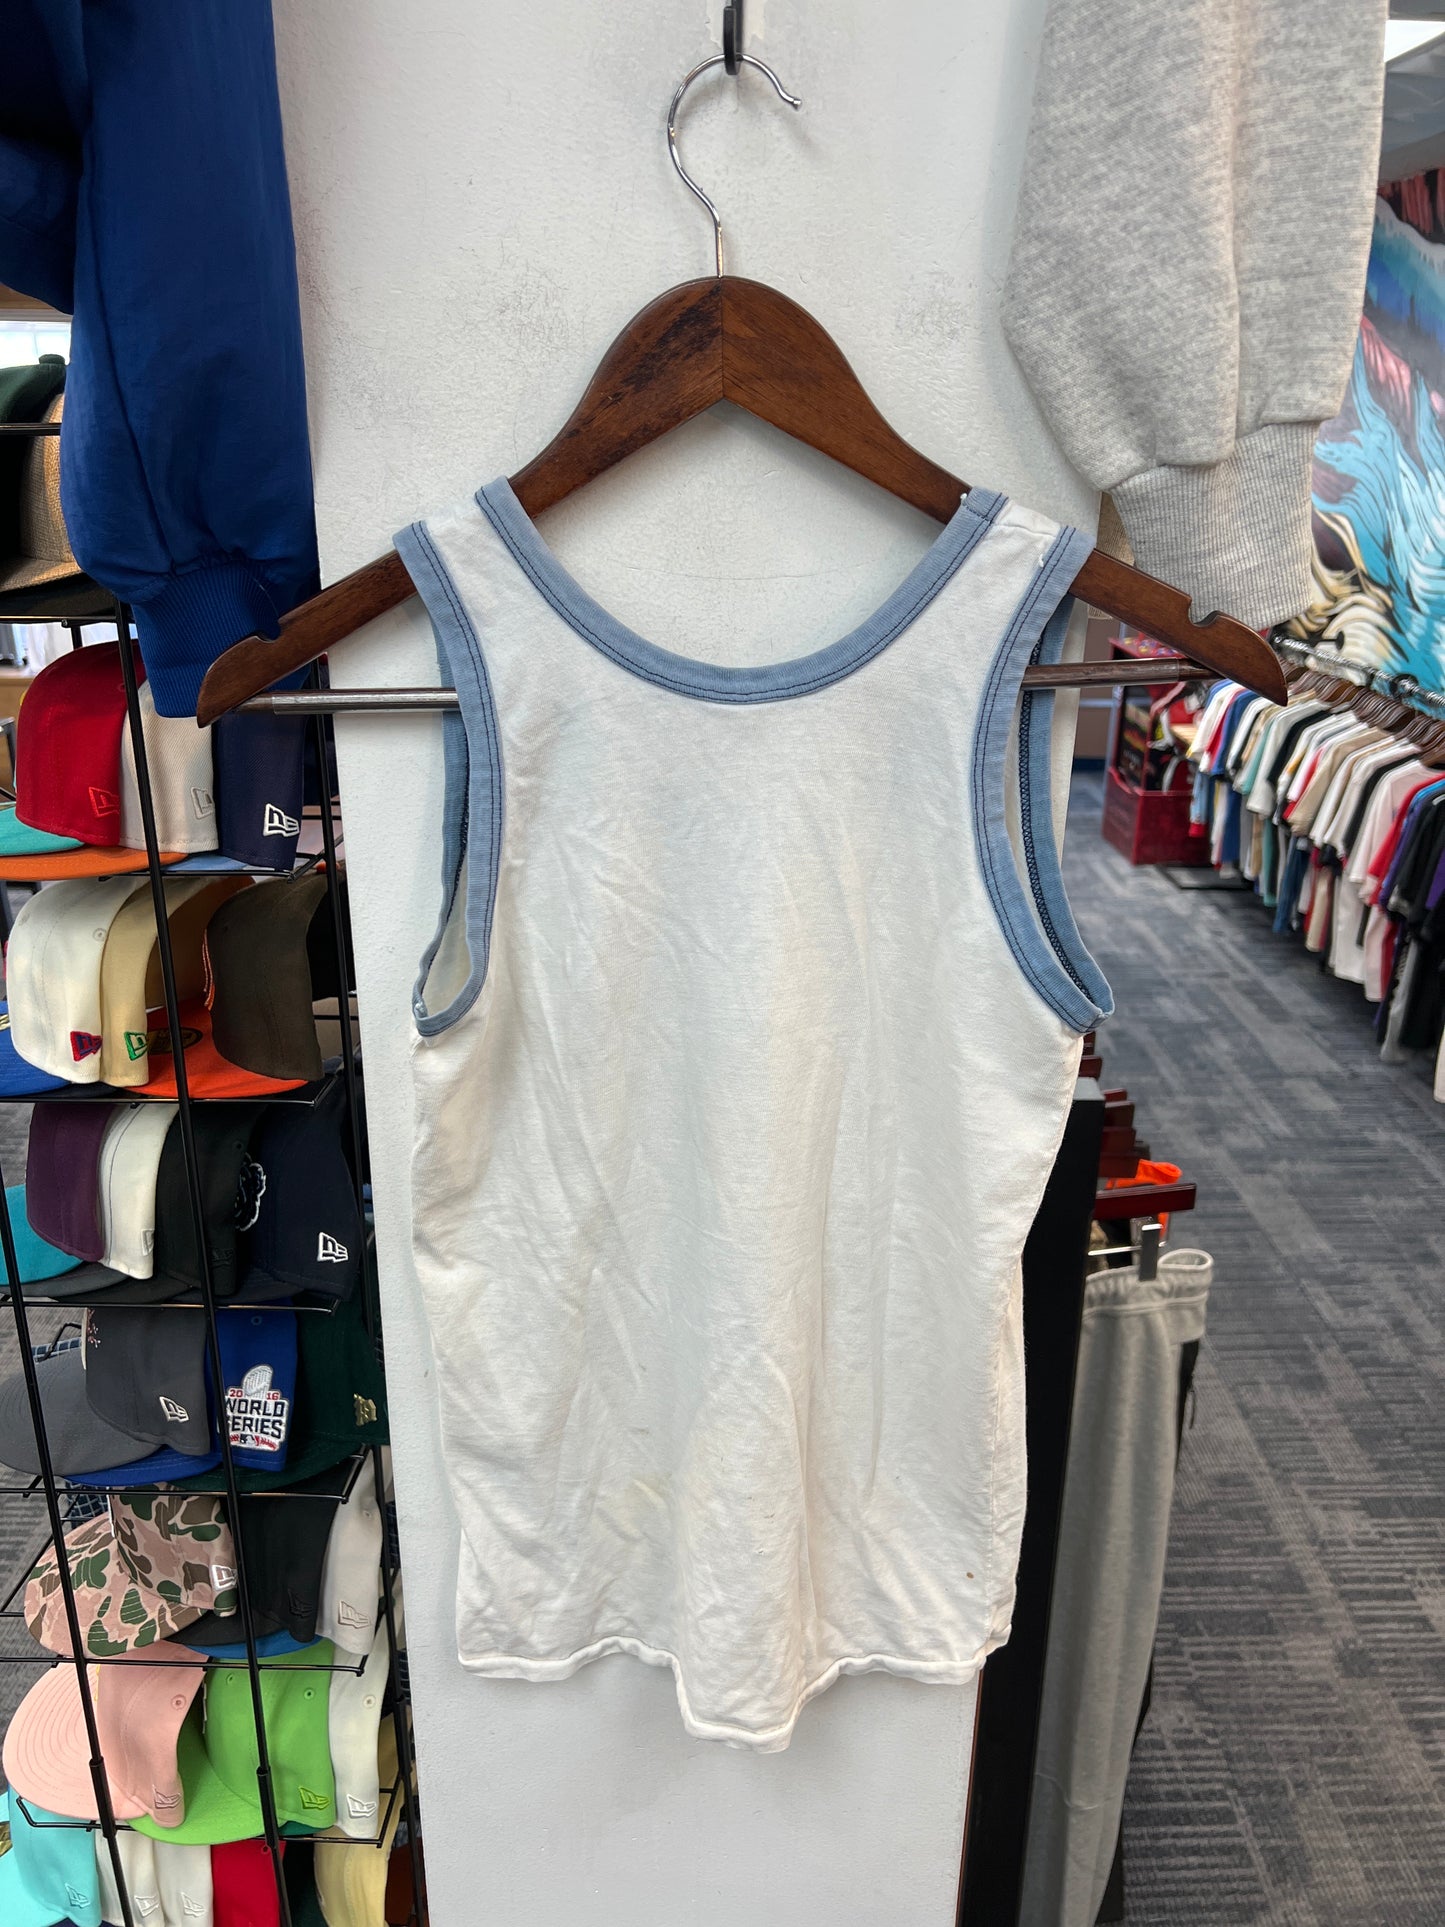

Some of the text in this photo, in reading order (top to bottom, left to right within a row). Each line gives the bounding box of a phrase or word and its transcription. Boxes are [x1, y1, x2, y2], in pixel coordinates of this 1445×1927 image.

[229, 1389, 280, 1401] 20 16
[225, 1398, 285, 1417] WORLD
[228, 1415, 283, 1440] ERIES
